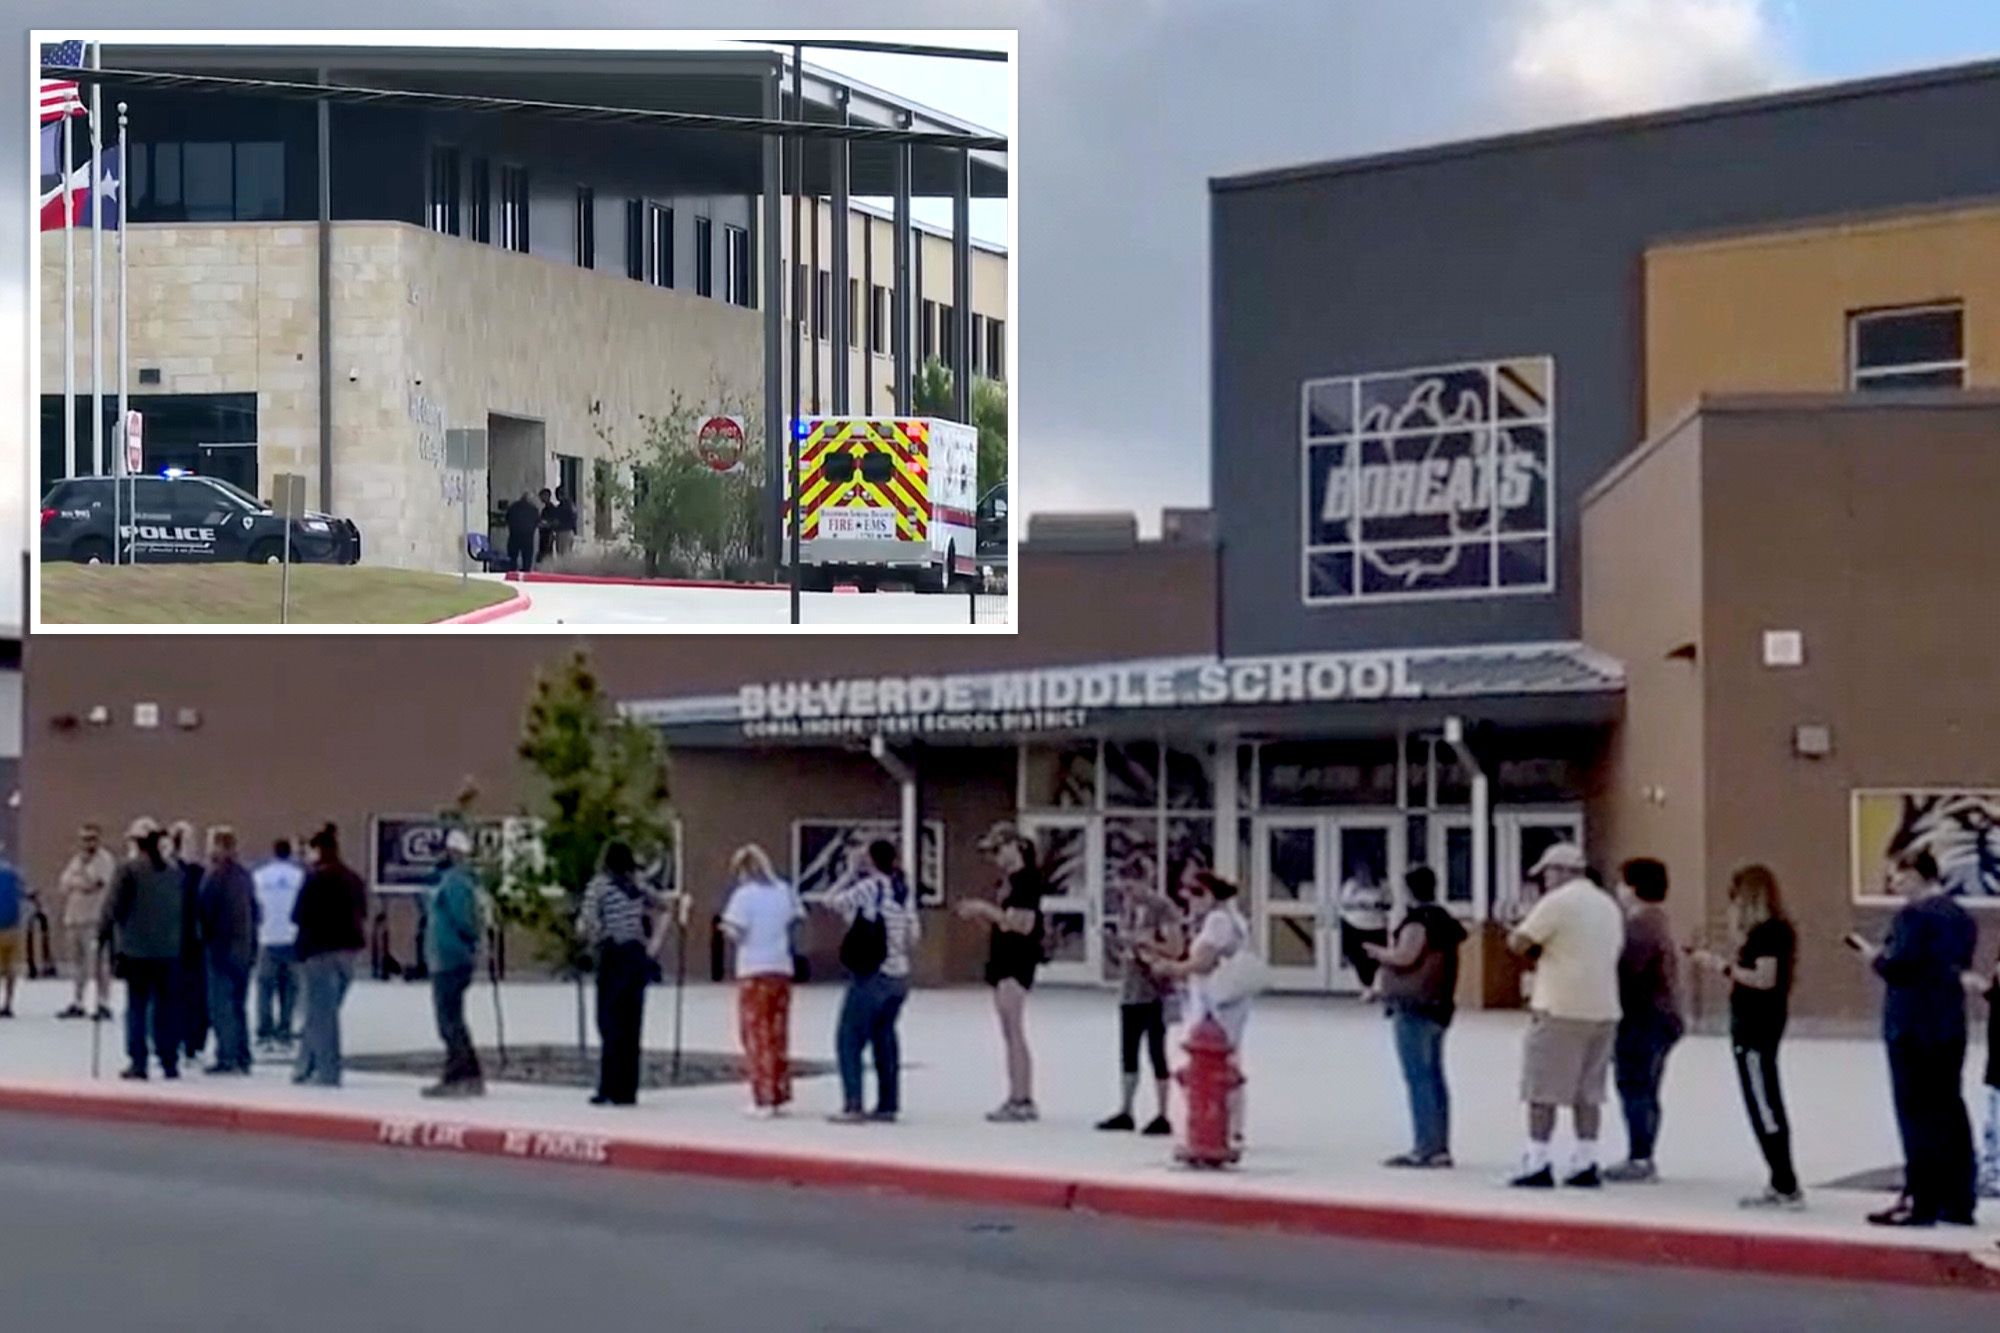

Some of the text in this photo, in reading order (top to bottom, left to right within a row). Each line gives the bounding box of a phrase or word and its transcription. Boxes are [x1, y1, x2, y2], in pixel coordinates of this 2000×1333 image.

[1321, 451, 1535, 523] BOBCATS
[120, 525, 217, 541] POLICE
[828, 518, 888, 532] FIRE EMS
[739, 656, 1423, 719] BULVERDE MIDDLE SCHOOL
[923, 712, 998, 731] SCHOOL
[420, 1122, 465, 1149] LANE
